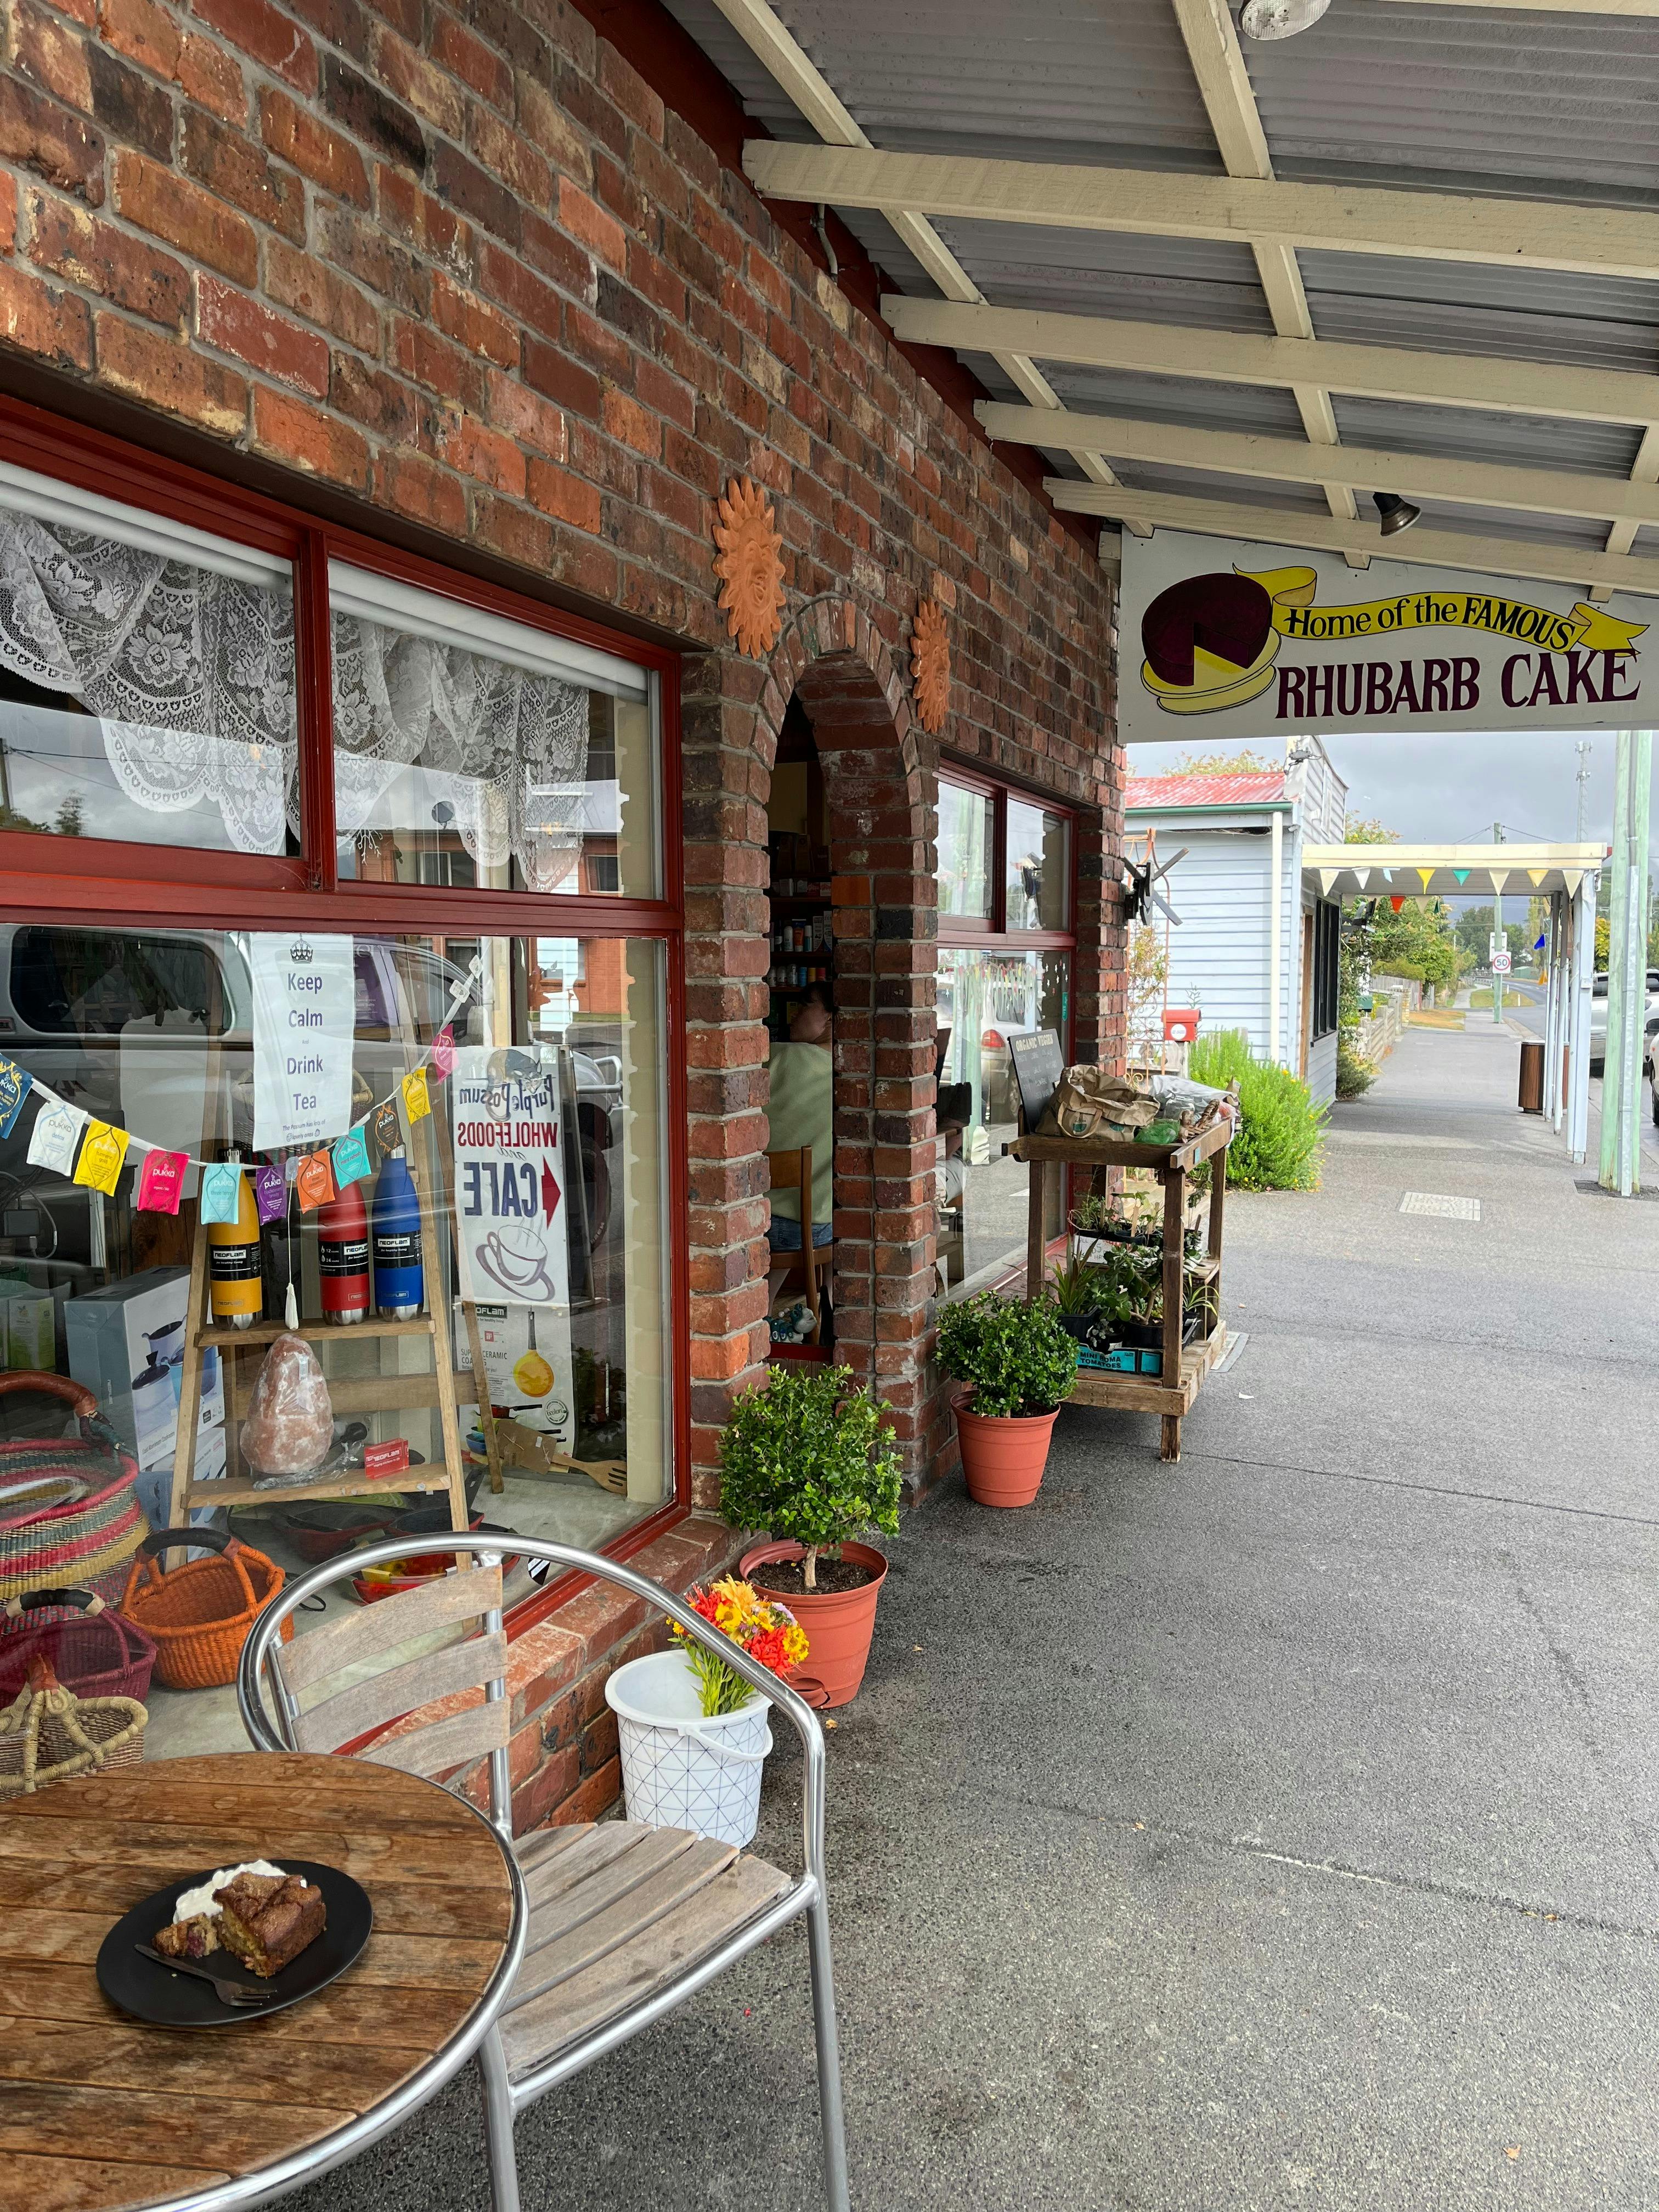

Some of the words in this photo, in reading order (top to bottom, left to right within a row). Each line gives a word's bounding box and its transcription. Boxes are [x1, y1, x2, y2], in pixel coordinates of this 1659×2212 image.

[1284, 608, 1372, 637] Home
[1377, 599, 1410, 629] of
[1414, 596, 1458, 624] the
[1462, 596, 1576, 650] FAMOUS
[1276, 657, 1480, 719] RHUBARB
[1501, 648, 1641, 708] CAKE
[288, 973, 323, 994] Keep
[288, 1008, 323, 1027] Calm
[1015, 1037, 1037, 1052] ORGANIC
[287, 1054, 323, 1075] Drink
[0, 1078, 17, 1094] ukka
[293, 1093, 317, 1111] Tea
[48, 1119, 71, 1133] pukka
[379, 1115, 394, 1128] pukka
[52, 1133, 65, 1141] detox
[153, 1169, 175, 1177] pukka
[306, 1166, 324, 1179] pukka
[264, 1179, 281, 1189] pukka
[482, 1350, 507, 1359] CERAMIC
[1099, 1354, 1121, 1363] ROMA
[1080, 1358, 1121, 1369] TOMATOES
